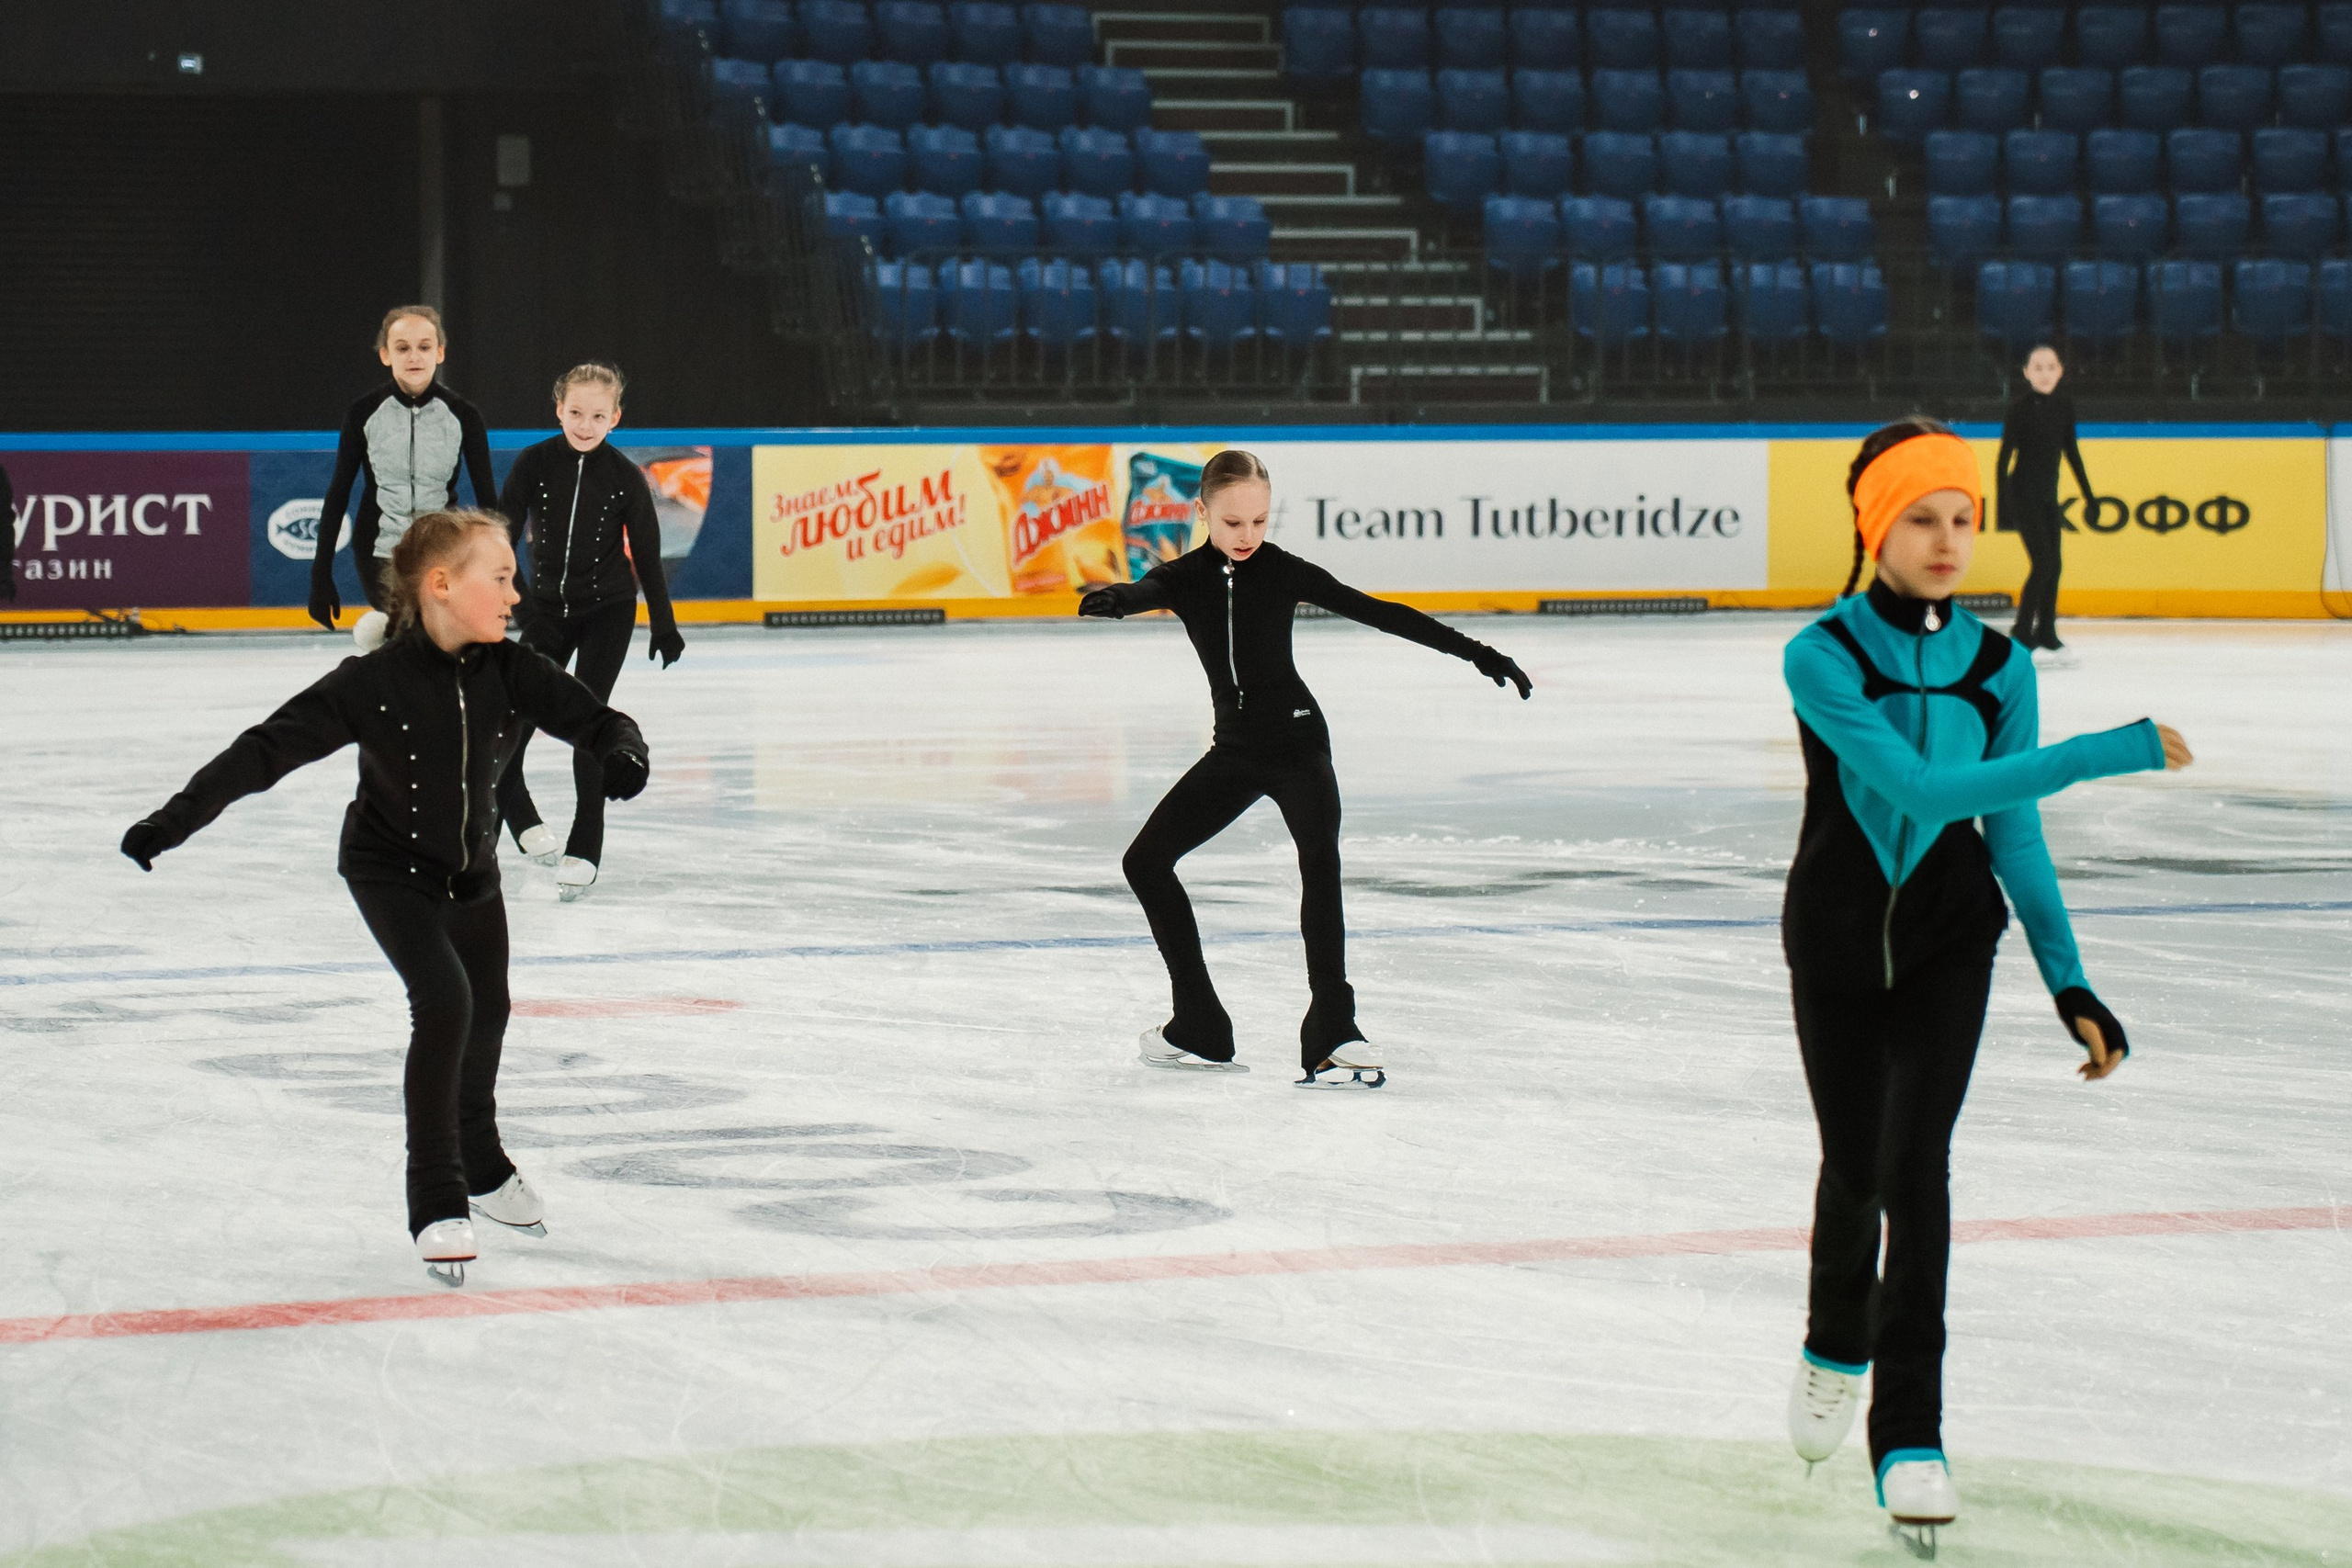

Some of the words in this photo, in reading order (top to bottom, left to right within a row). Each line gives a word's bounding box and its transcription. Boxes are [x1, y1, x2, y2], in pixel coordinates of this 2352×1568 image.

[780, 468, 953, 558] любим
[846, 536, 865, 562] и
[872, 493, 966, 560] едим!
[1306, 497, 1443, 539] Team
[1459, 494, 1742, 539] Tutberidze
[12, 558, 112, 581] азин
